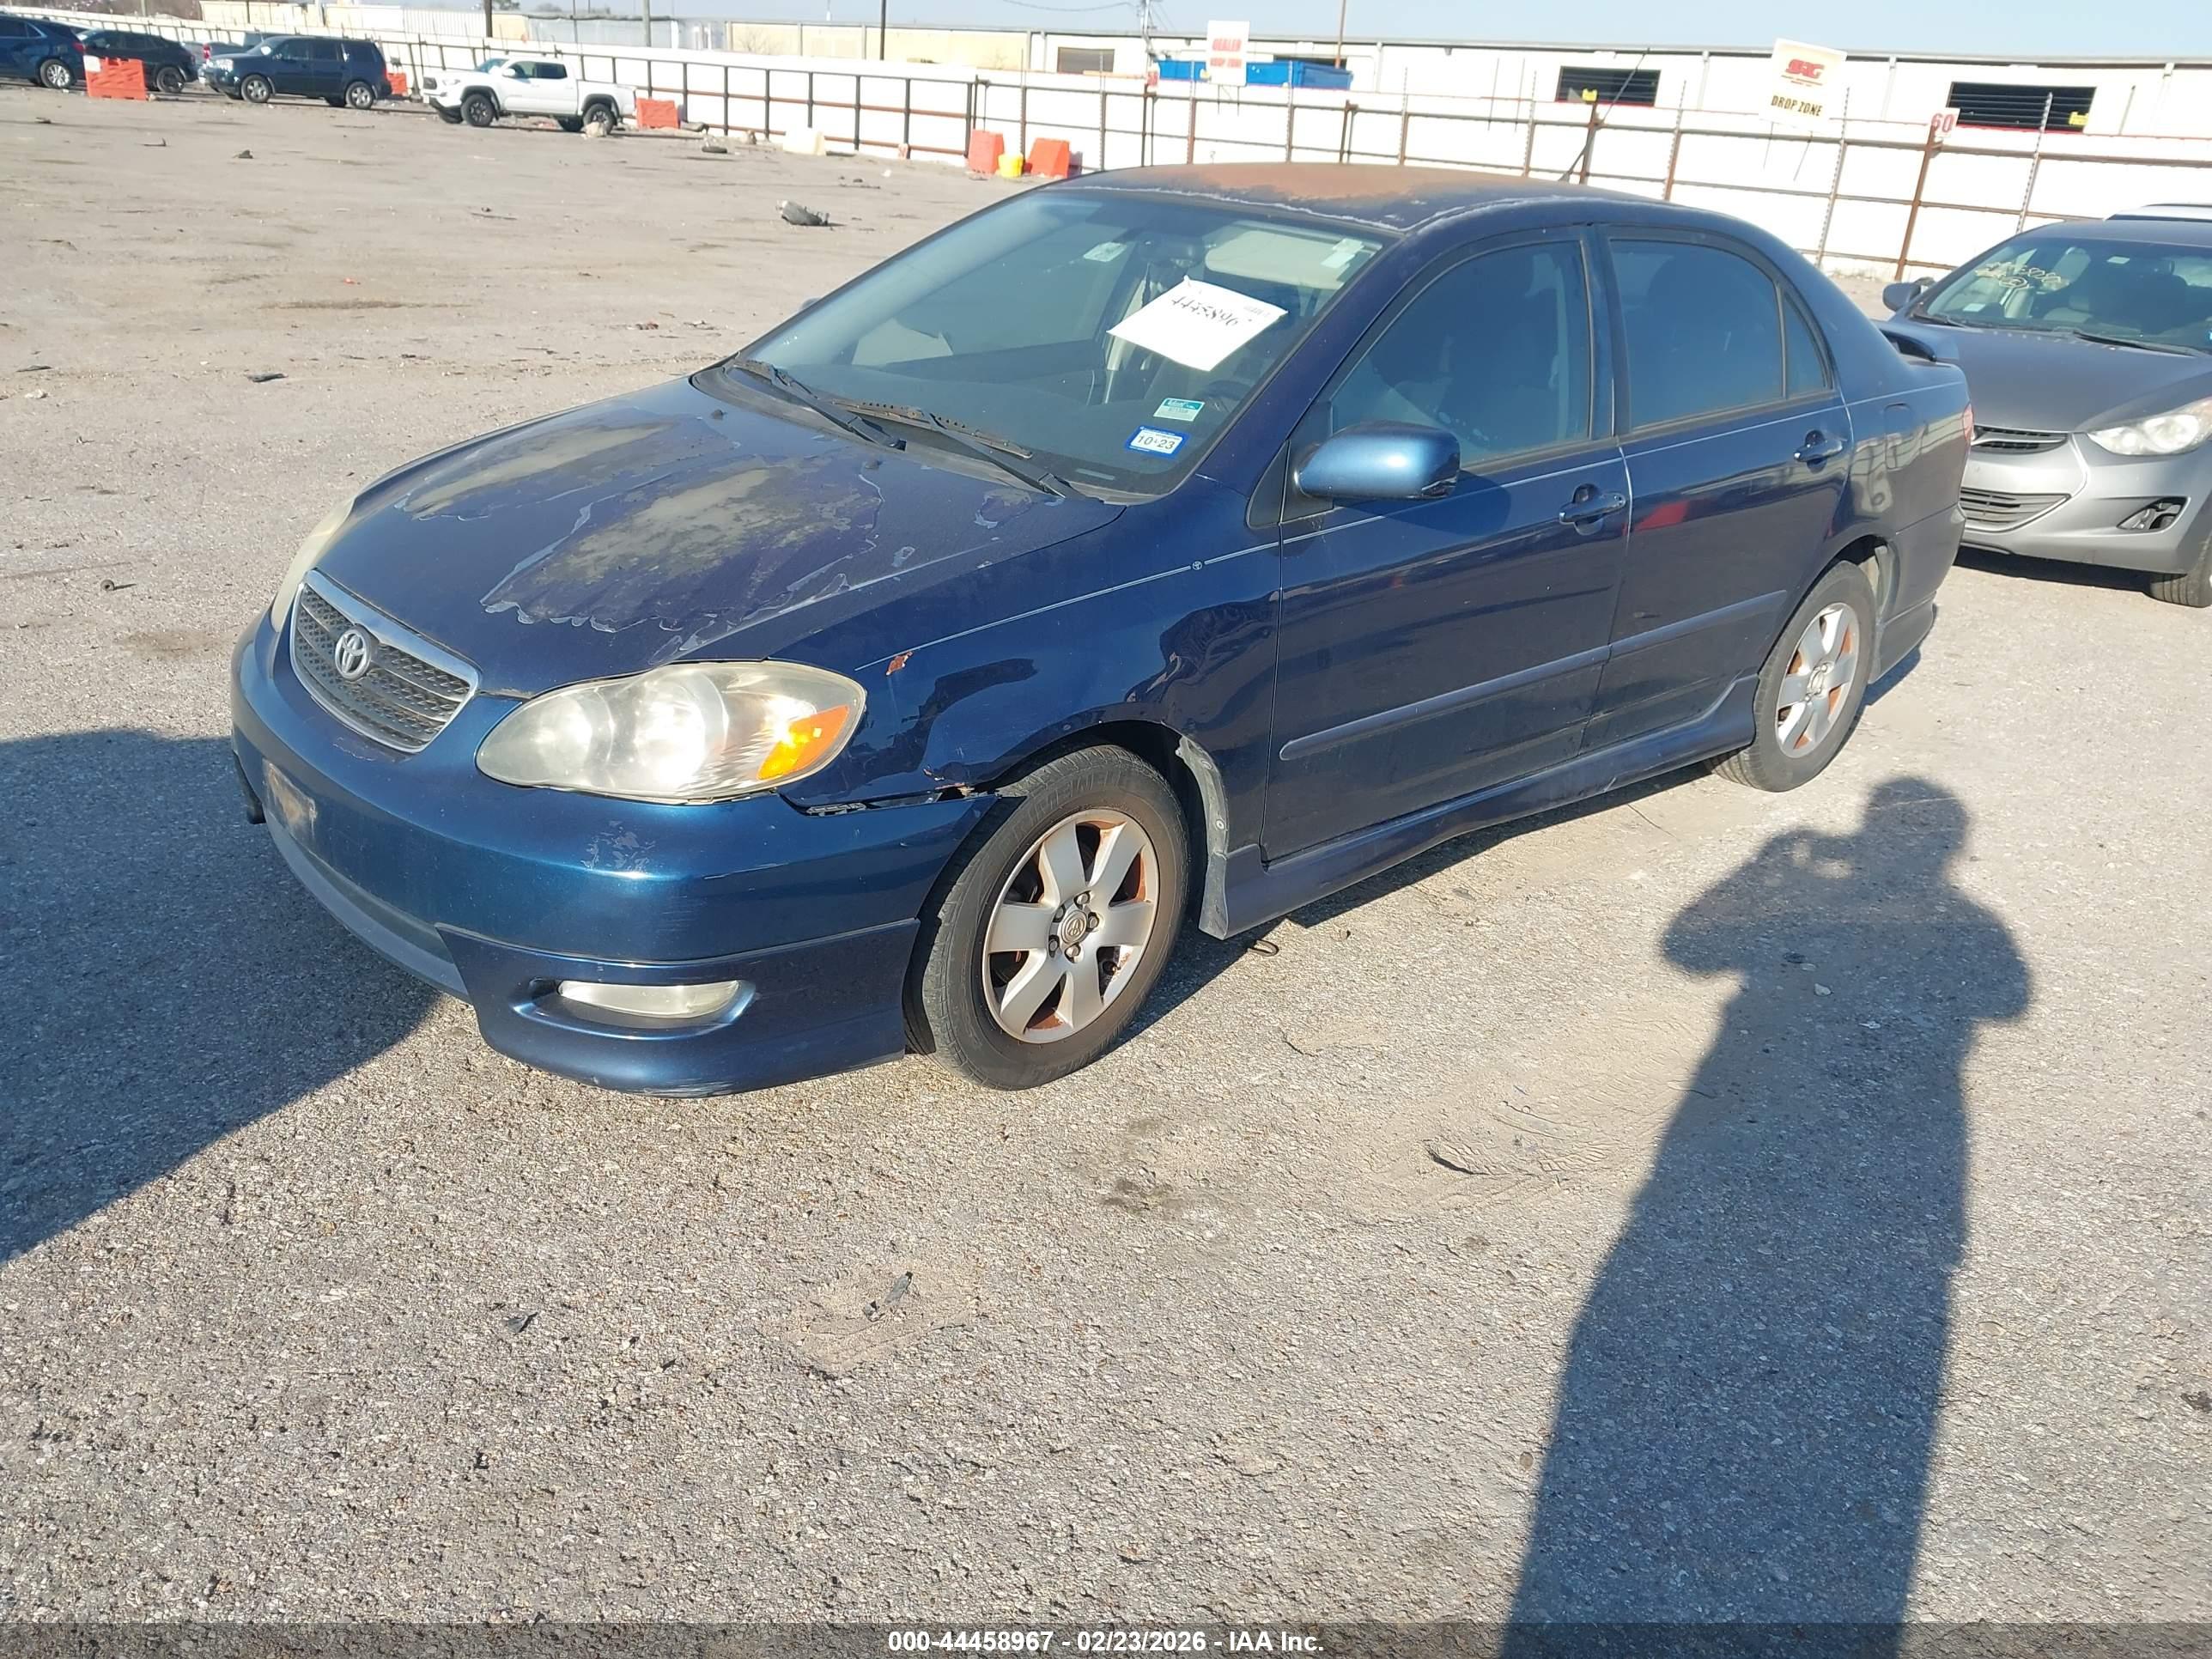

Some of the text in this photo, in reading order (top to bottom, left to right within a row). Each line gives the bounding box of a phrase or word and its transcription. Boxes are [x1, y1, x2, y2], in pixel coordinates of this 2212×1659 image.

[1771, 95, 1823, 117] DROP ZONE
[1931, 112, 1955, 133] 60
